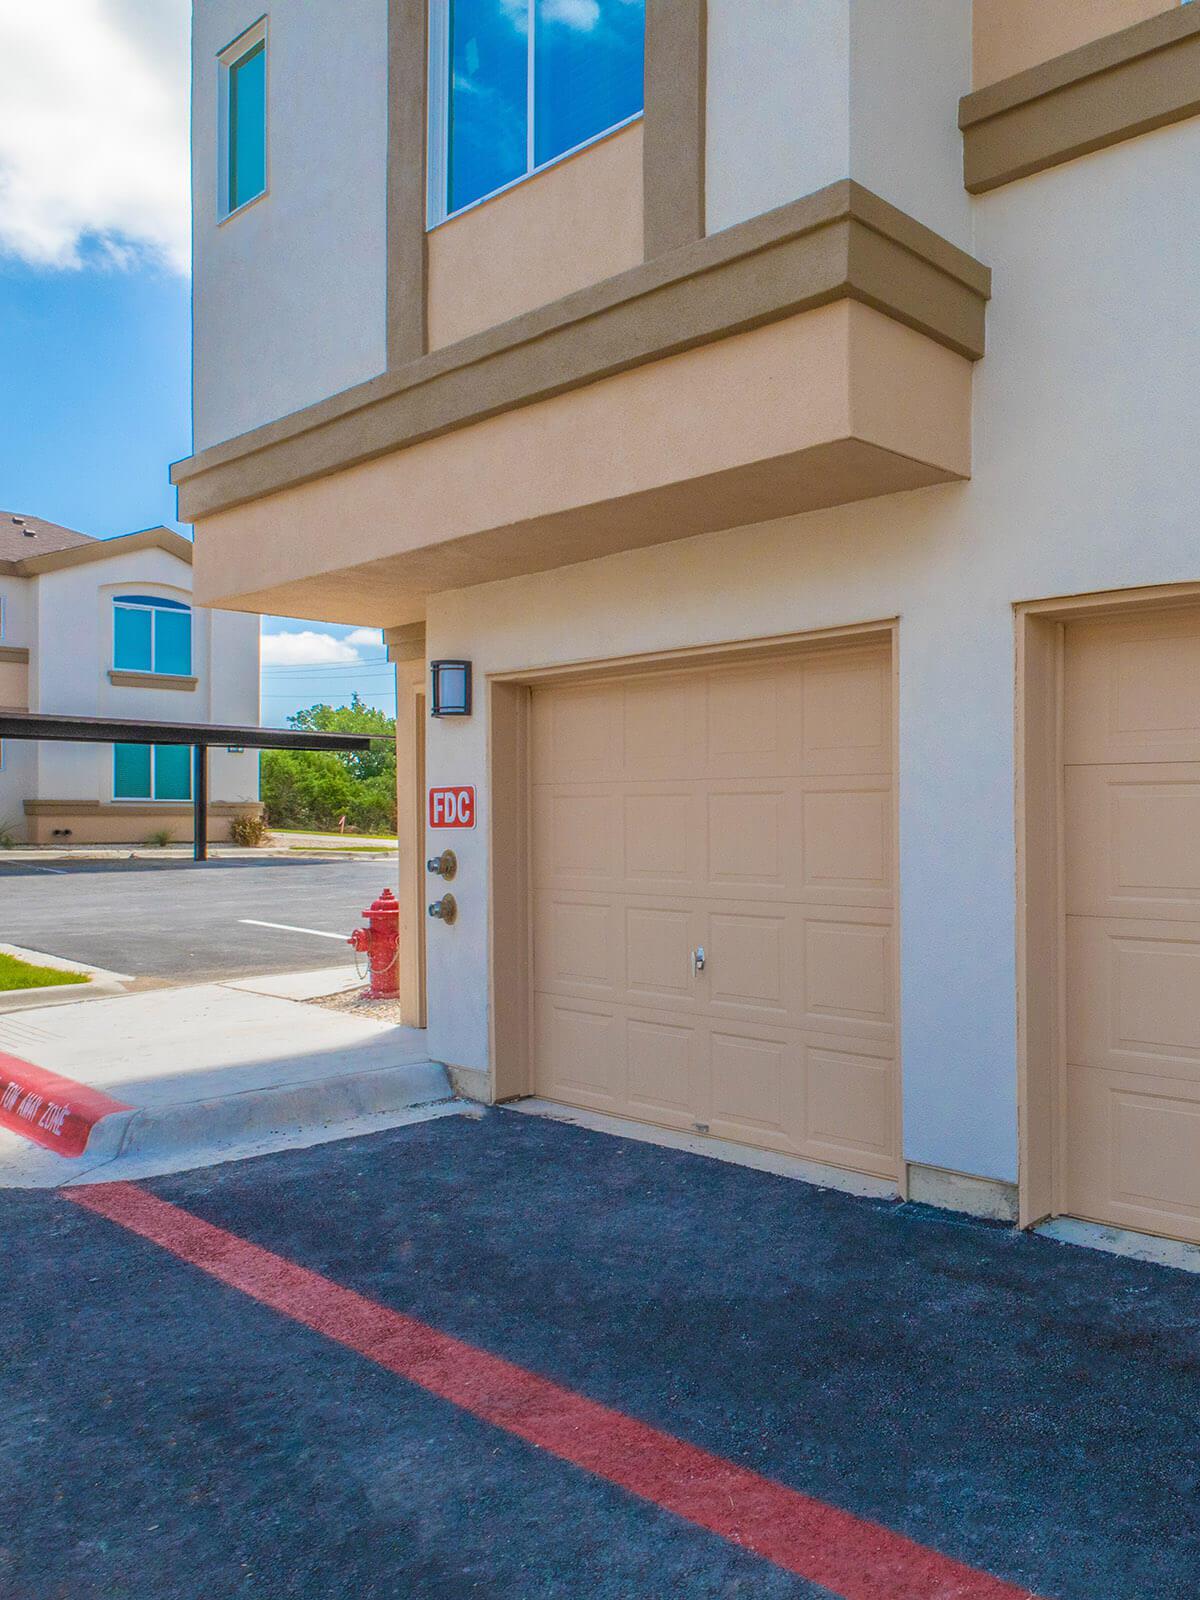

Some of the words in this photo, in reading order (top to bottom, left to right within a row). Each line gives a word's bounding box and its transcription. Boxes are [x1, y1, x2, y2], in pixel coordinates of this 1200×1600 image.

[433, 791, 470, 824] FDC
[0, 1081, 25, 1112] TOW
[16, 1091, 43, 1122] AWAY
[38, 1102, 71, 1136] ZONE
